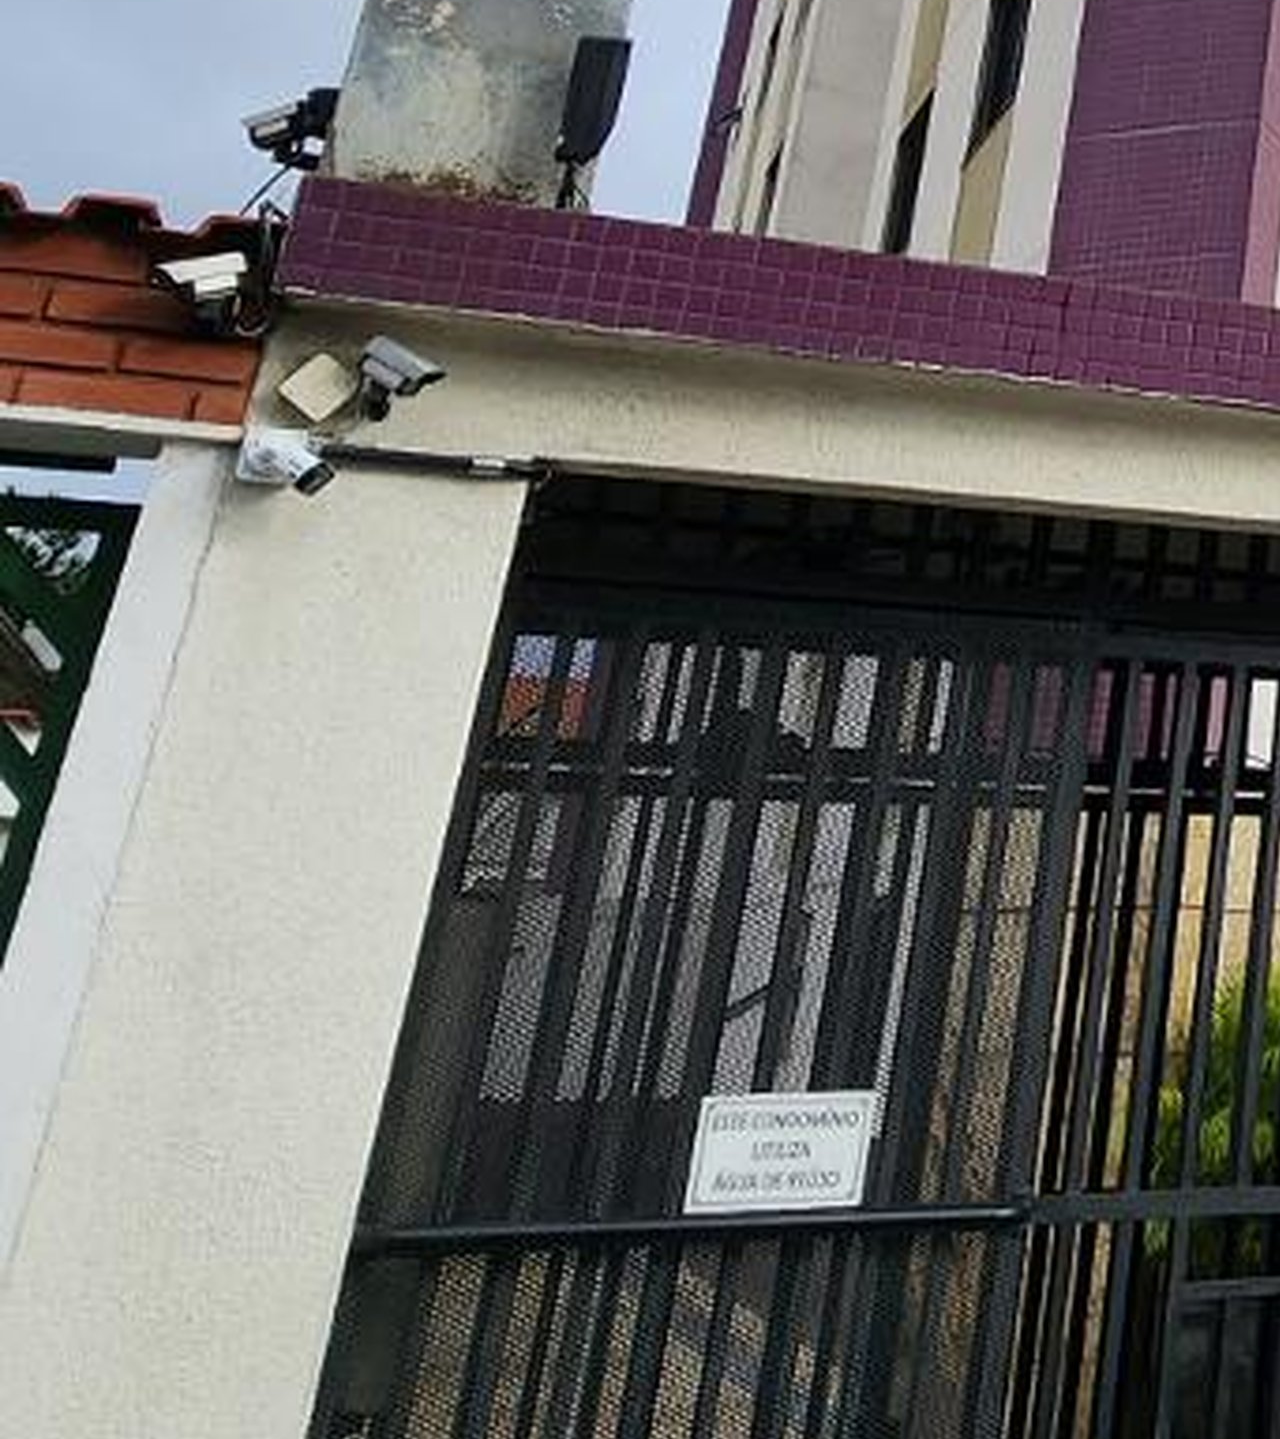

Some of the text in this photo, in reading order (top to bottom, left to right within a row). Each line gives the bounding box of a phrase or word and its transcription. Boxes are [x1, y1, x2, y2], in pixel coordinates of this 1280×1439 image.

[711, 1111, 747, 1132] ESTE
[750, 1140, 811, 1161] UTILIZA
[761, 1171, 786, 1190] DE
